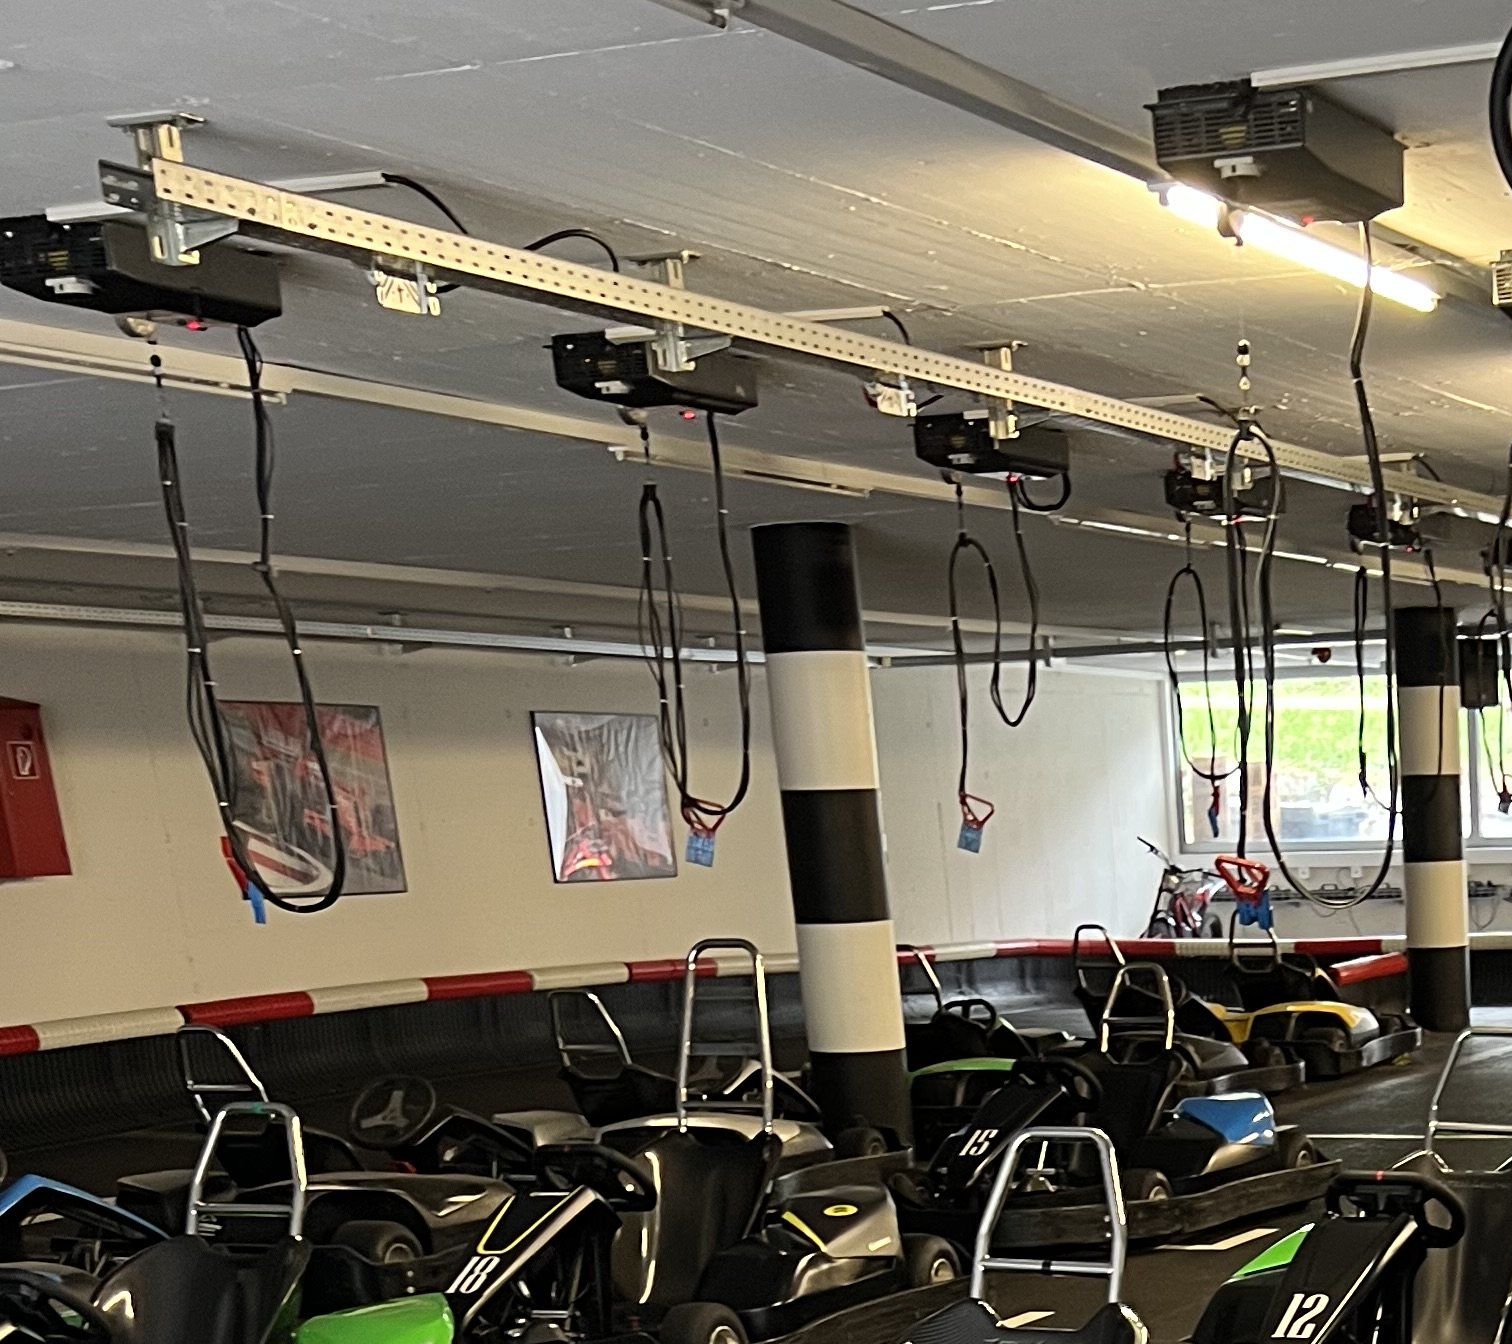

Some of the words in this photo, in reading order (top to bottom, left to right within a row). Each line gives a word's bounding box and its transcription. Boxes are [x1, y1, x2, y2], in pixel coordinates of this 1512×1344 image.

[959, 1129, 999, 1156] 15
[444, 1256, 500, 1294] 18
[1271, 1293, 1330, 1339] 12
